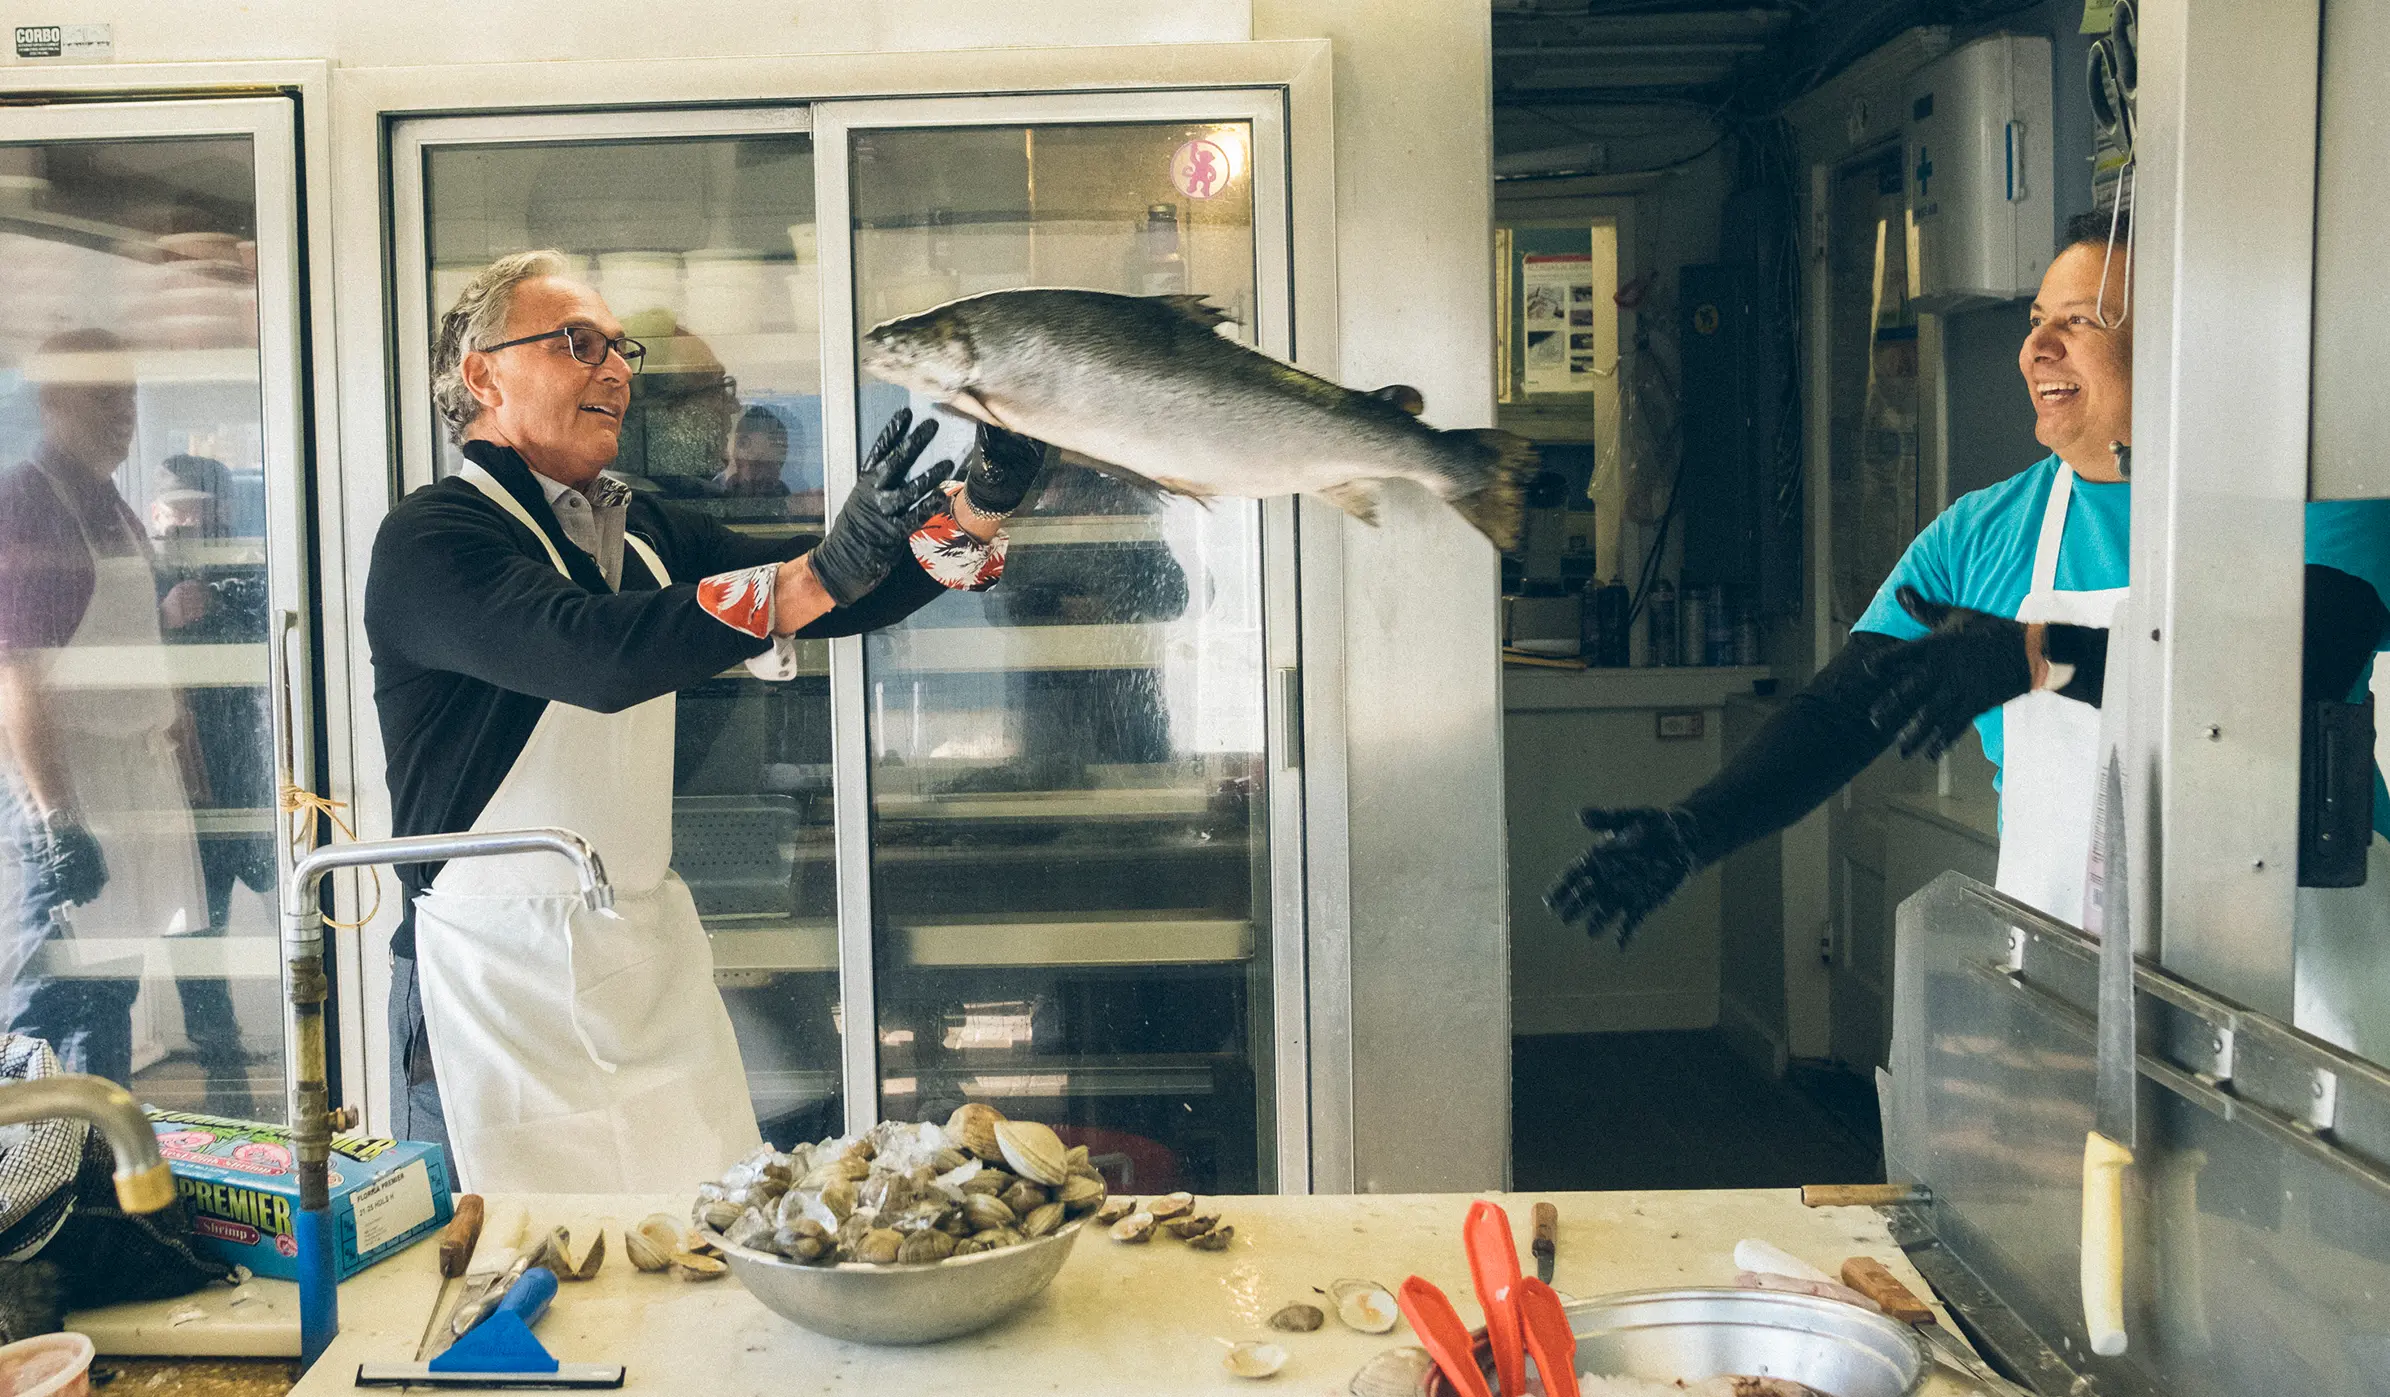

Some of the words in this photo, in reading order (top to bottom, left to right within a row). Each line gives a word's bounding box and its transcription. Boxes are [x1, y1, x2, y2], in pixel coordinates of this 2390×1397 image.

[16, 28, 60, 43] CORBO
[178, 1178, 294, 1237] PREMIER
[203, 1221, 248, 1241] Shrimp
